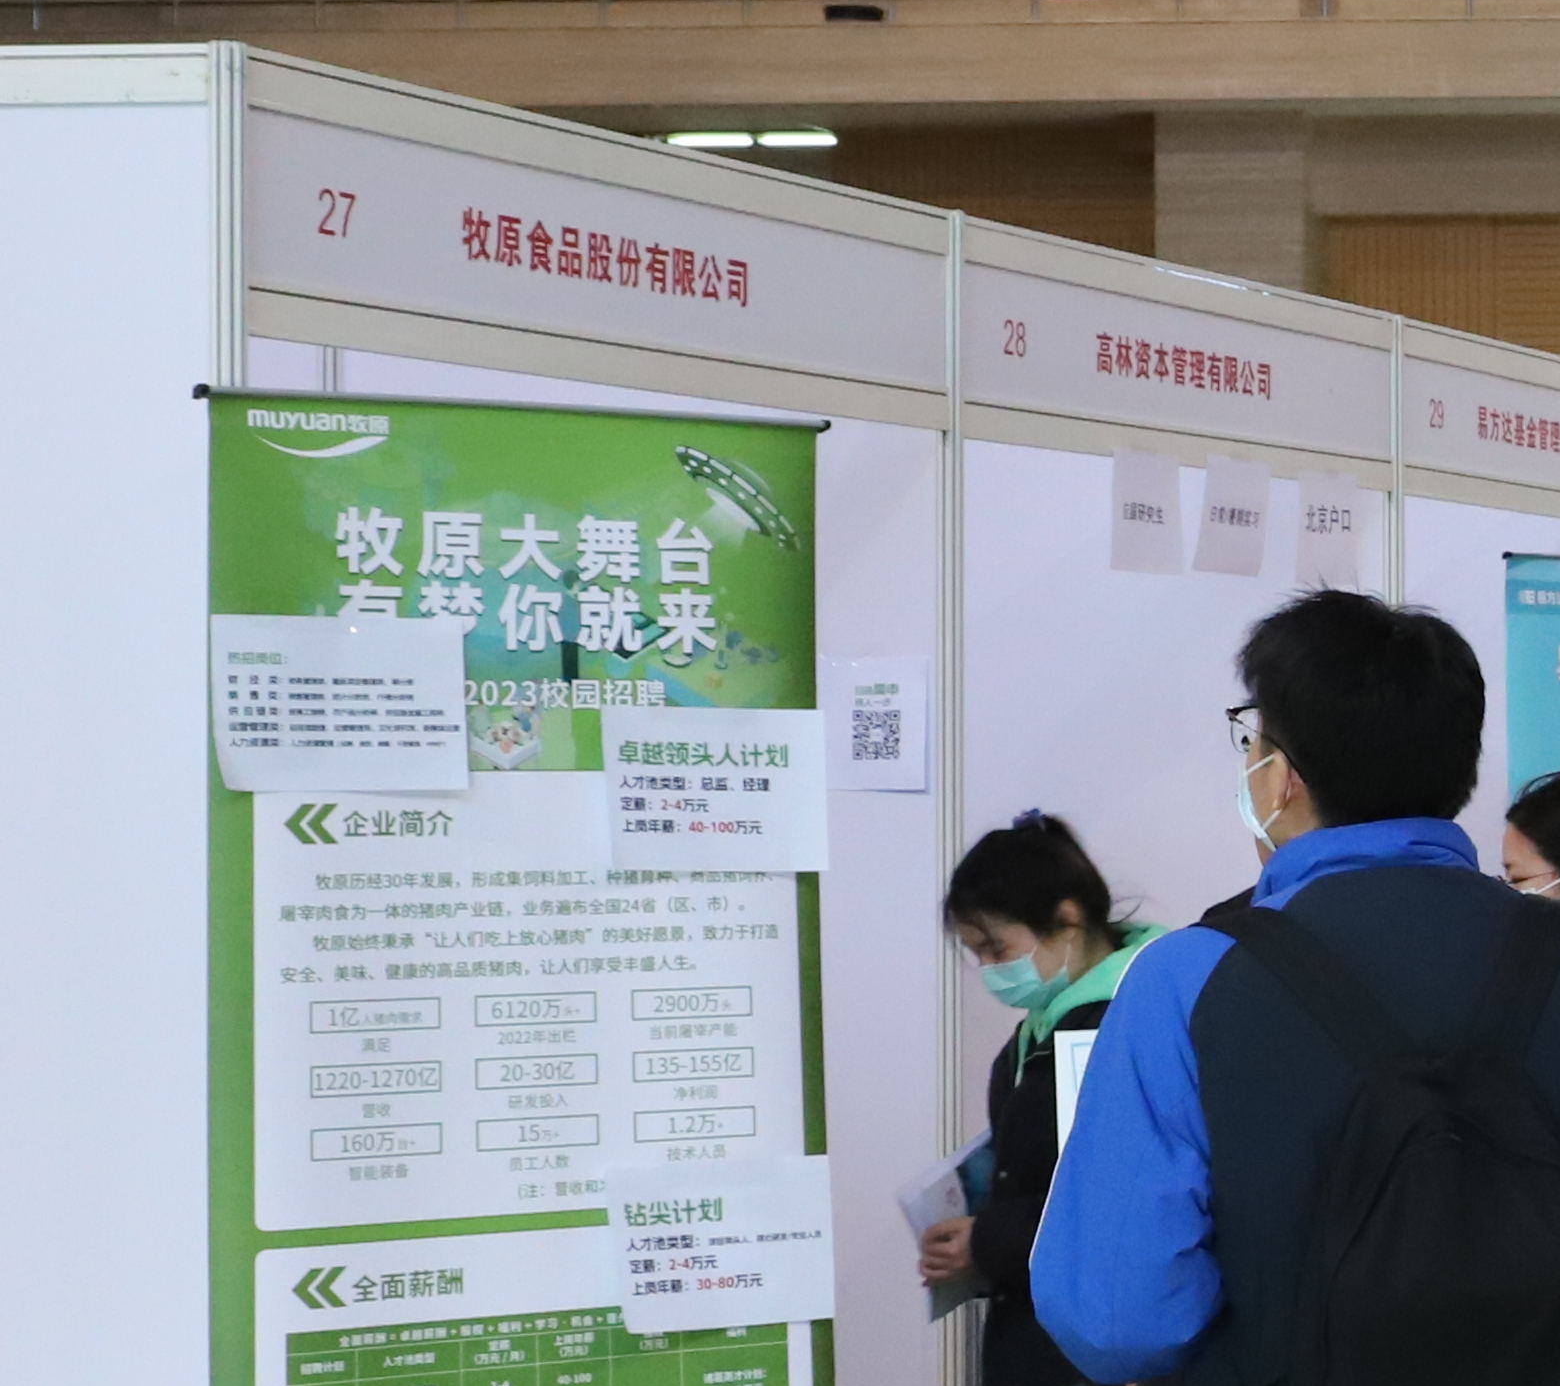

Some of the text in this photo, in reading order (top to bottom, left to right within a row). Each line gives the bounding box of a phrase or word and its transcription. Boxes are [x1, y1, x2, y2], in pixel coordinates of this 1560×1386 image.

[318, 188, 750, 309] 27 牧原食品股份有限公司
[1003, 319, 1273, 400] 28 高林资本管理有限公司
[1429, 399, 1445, 430] 29
[1305, 504, 1352, 534] 北京户口
[335, 506, 716, 586] 牧原大舞台
[617, 740, 790, 769] 卓越领头人计划
[342, 809, 455, 840] 企业简介
[499, 1061, 577, 1082] 20-30亿
[645, 1053, 743, 1075] 135-155亿
[313, 1067, 439, 1092] 1220-1270亿
[623, 1197, 723, 1227] 钻尖计划
[351, 1266, 465, 1303] 全面薪酬
